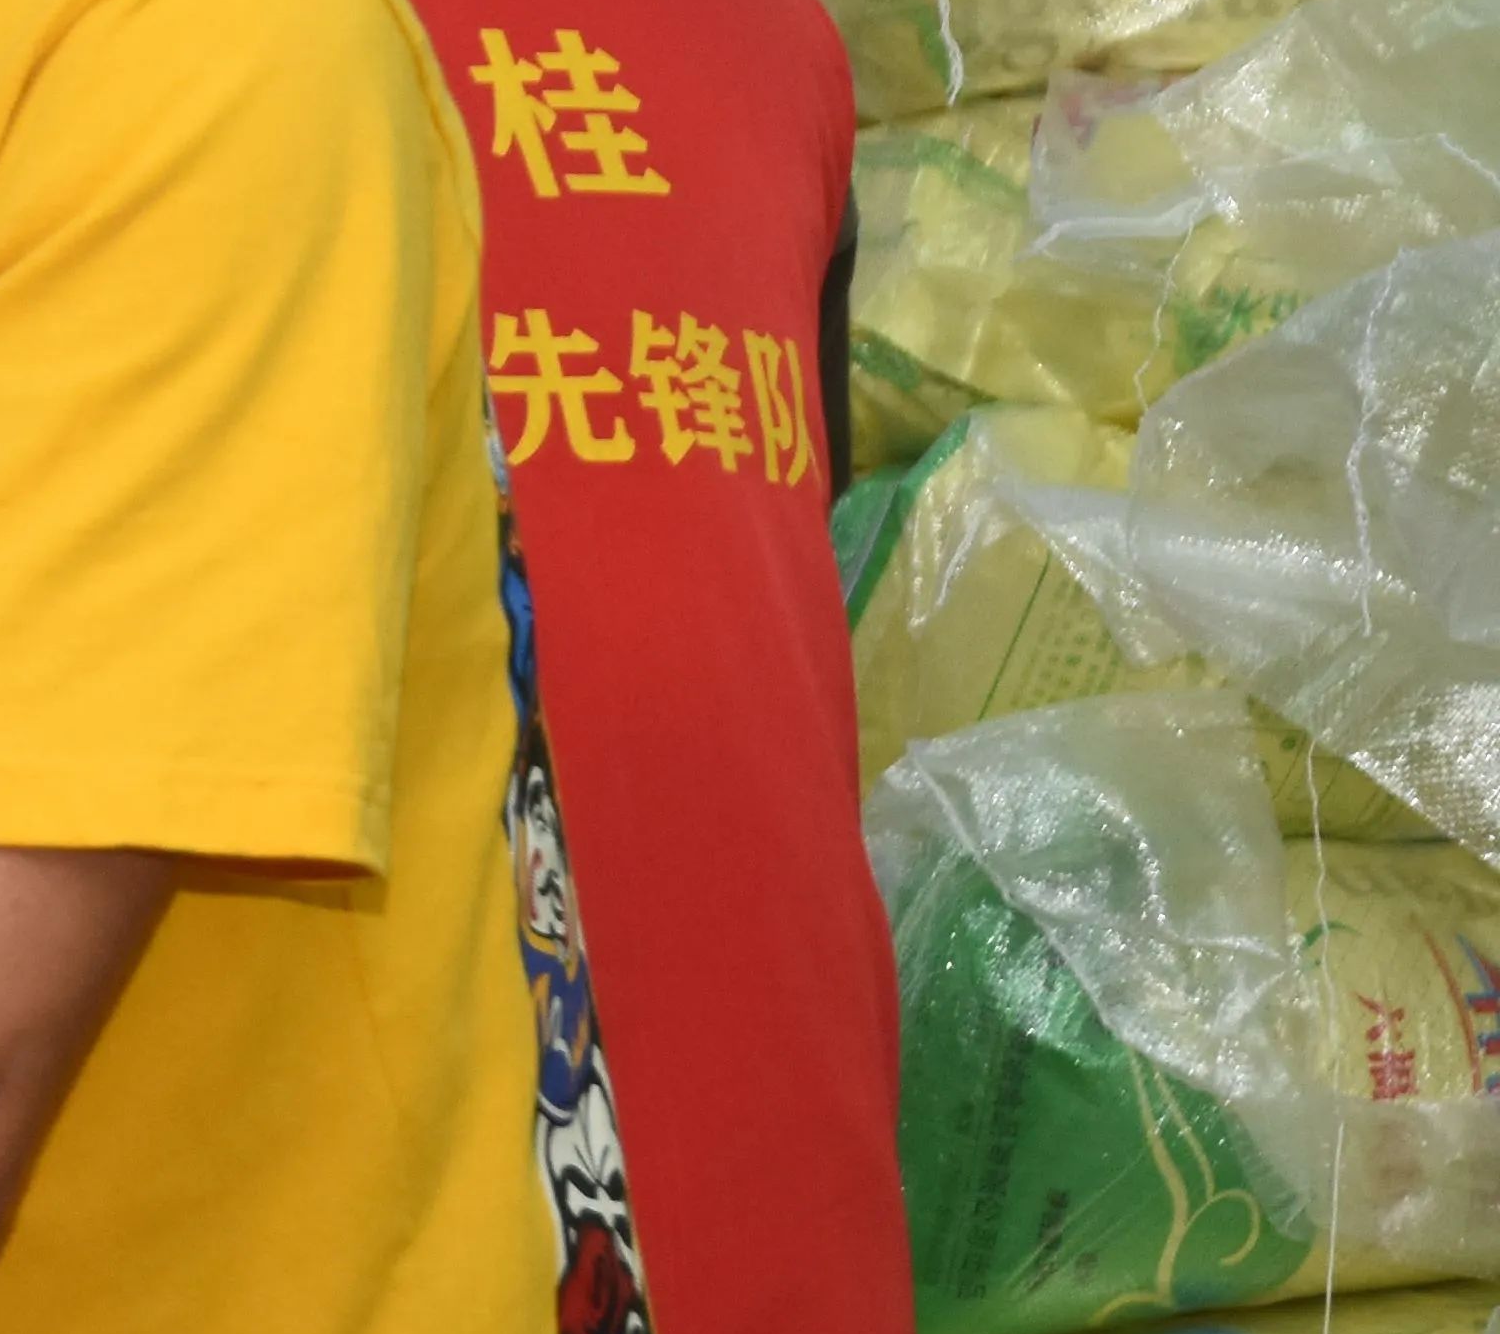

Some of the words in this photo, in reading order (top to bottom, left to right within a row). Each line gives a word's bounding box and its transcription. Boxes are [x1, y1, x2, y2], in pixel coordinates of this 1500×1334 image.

[469, 27, 672, 198] 桂
[488, 308, 826, 489] 先锋队
